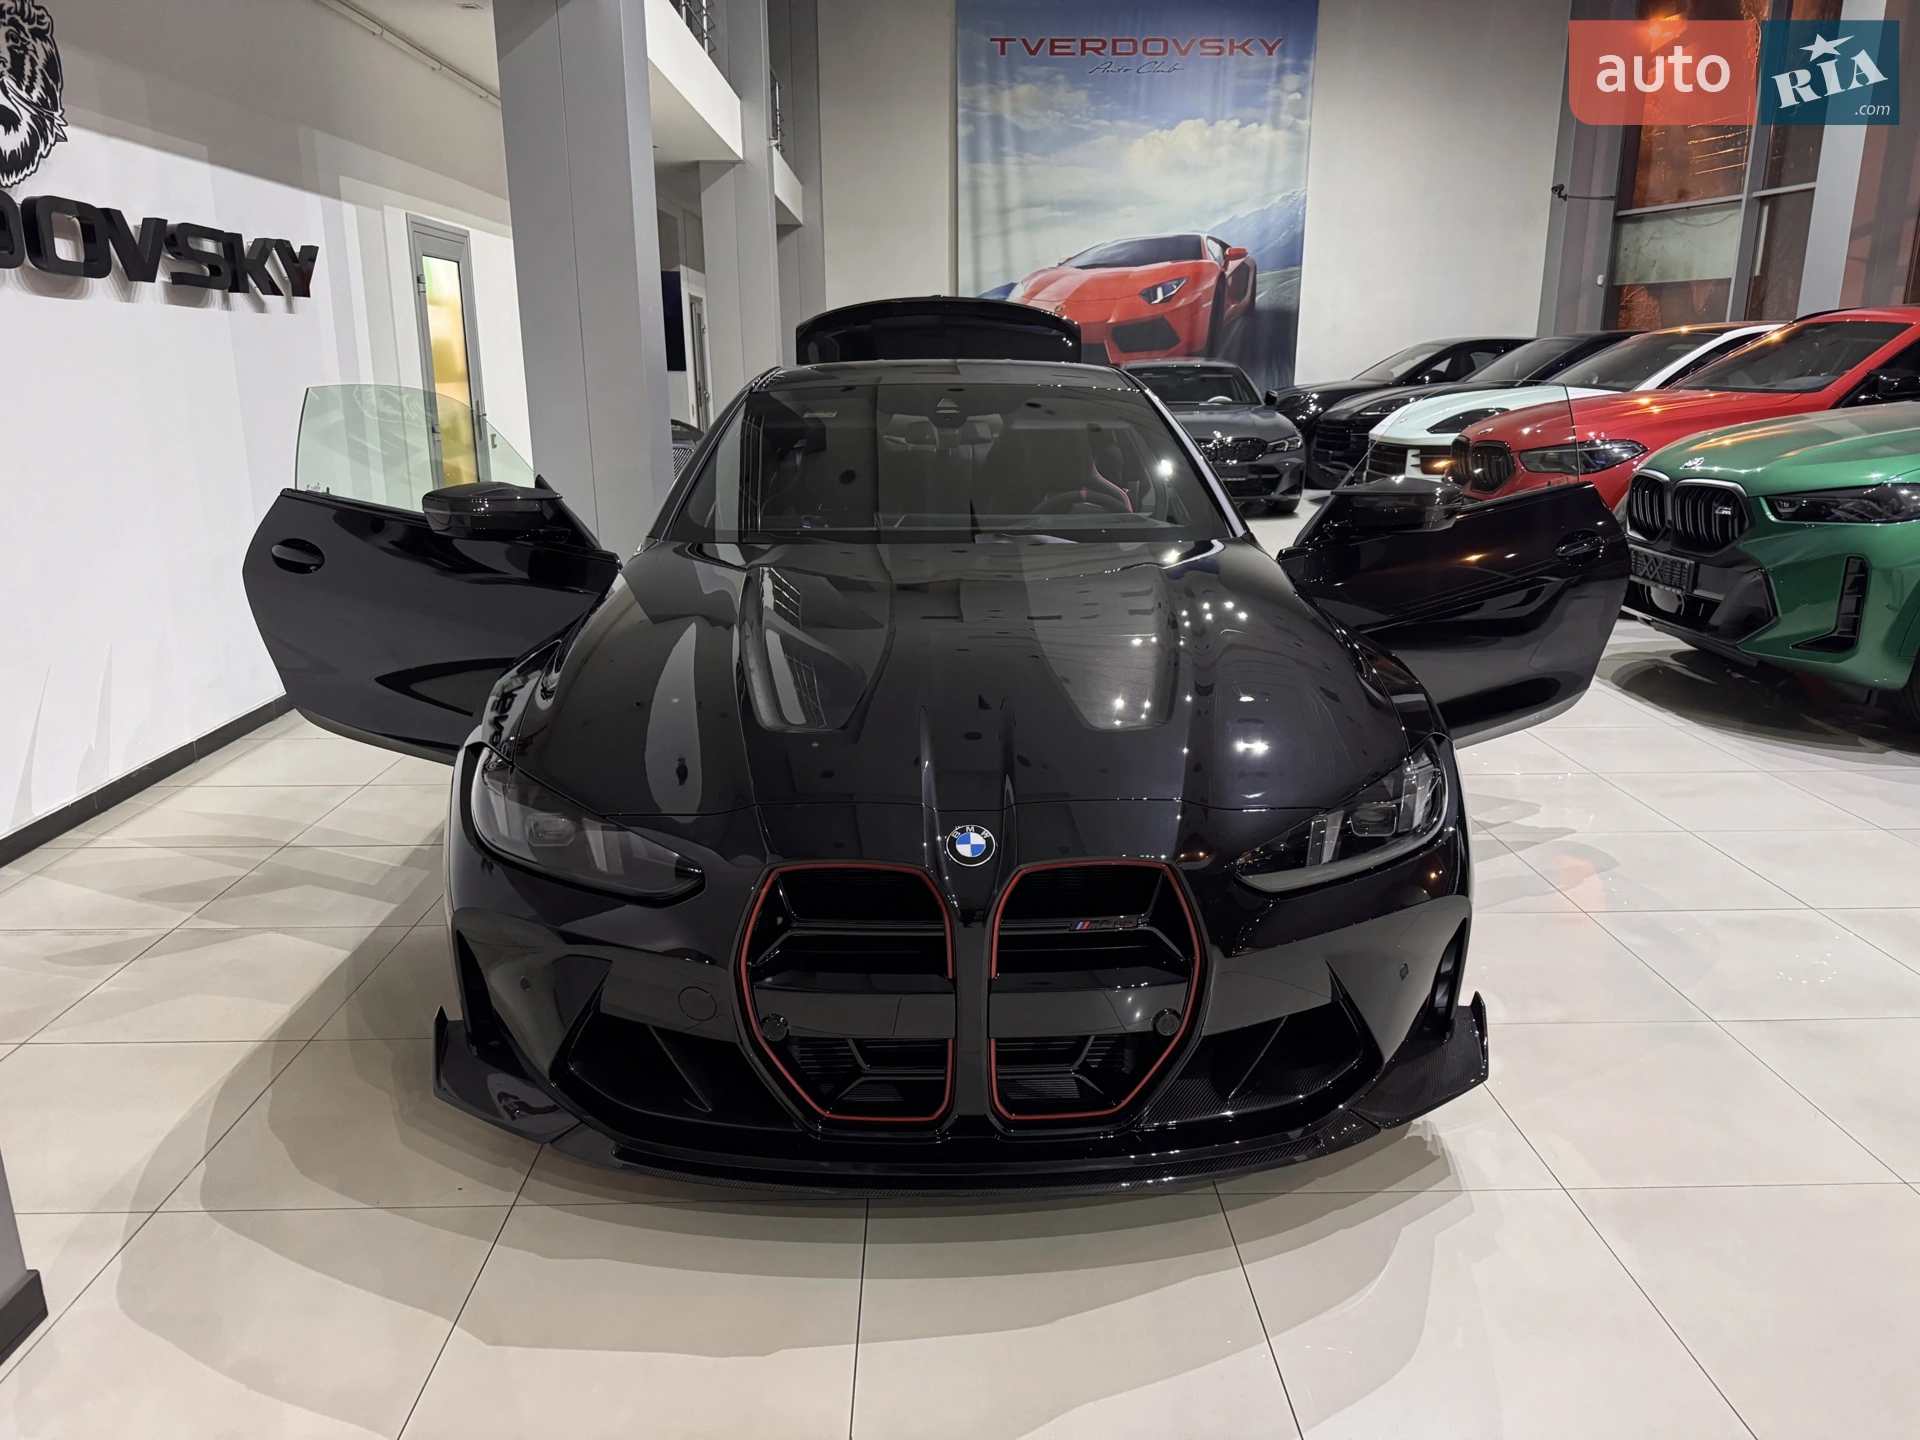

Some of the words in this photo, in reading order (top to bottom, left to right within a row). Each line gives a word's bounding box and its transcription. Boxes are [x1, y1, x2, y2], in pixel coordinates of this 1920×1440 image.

[989, 37, 1285, 57] TVERDOVSKY
[1088, 60, 1133, 75] Auto
[1136, 60, 1185, 75] Club
[950, 825, 991, 839] BMW
